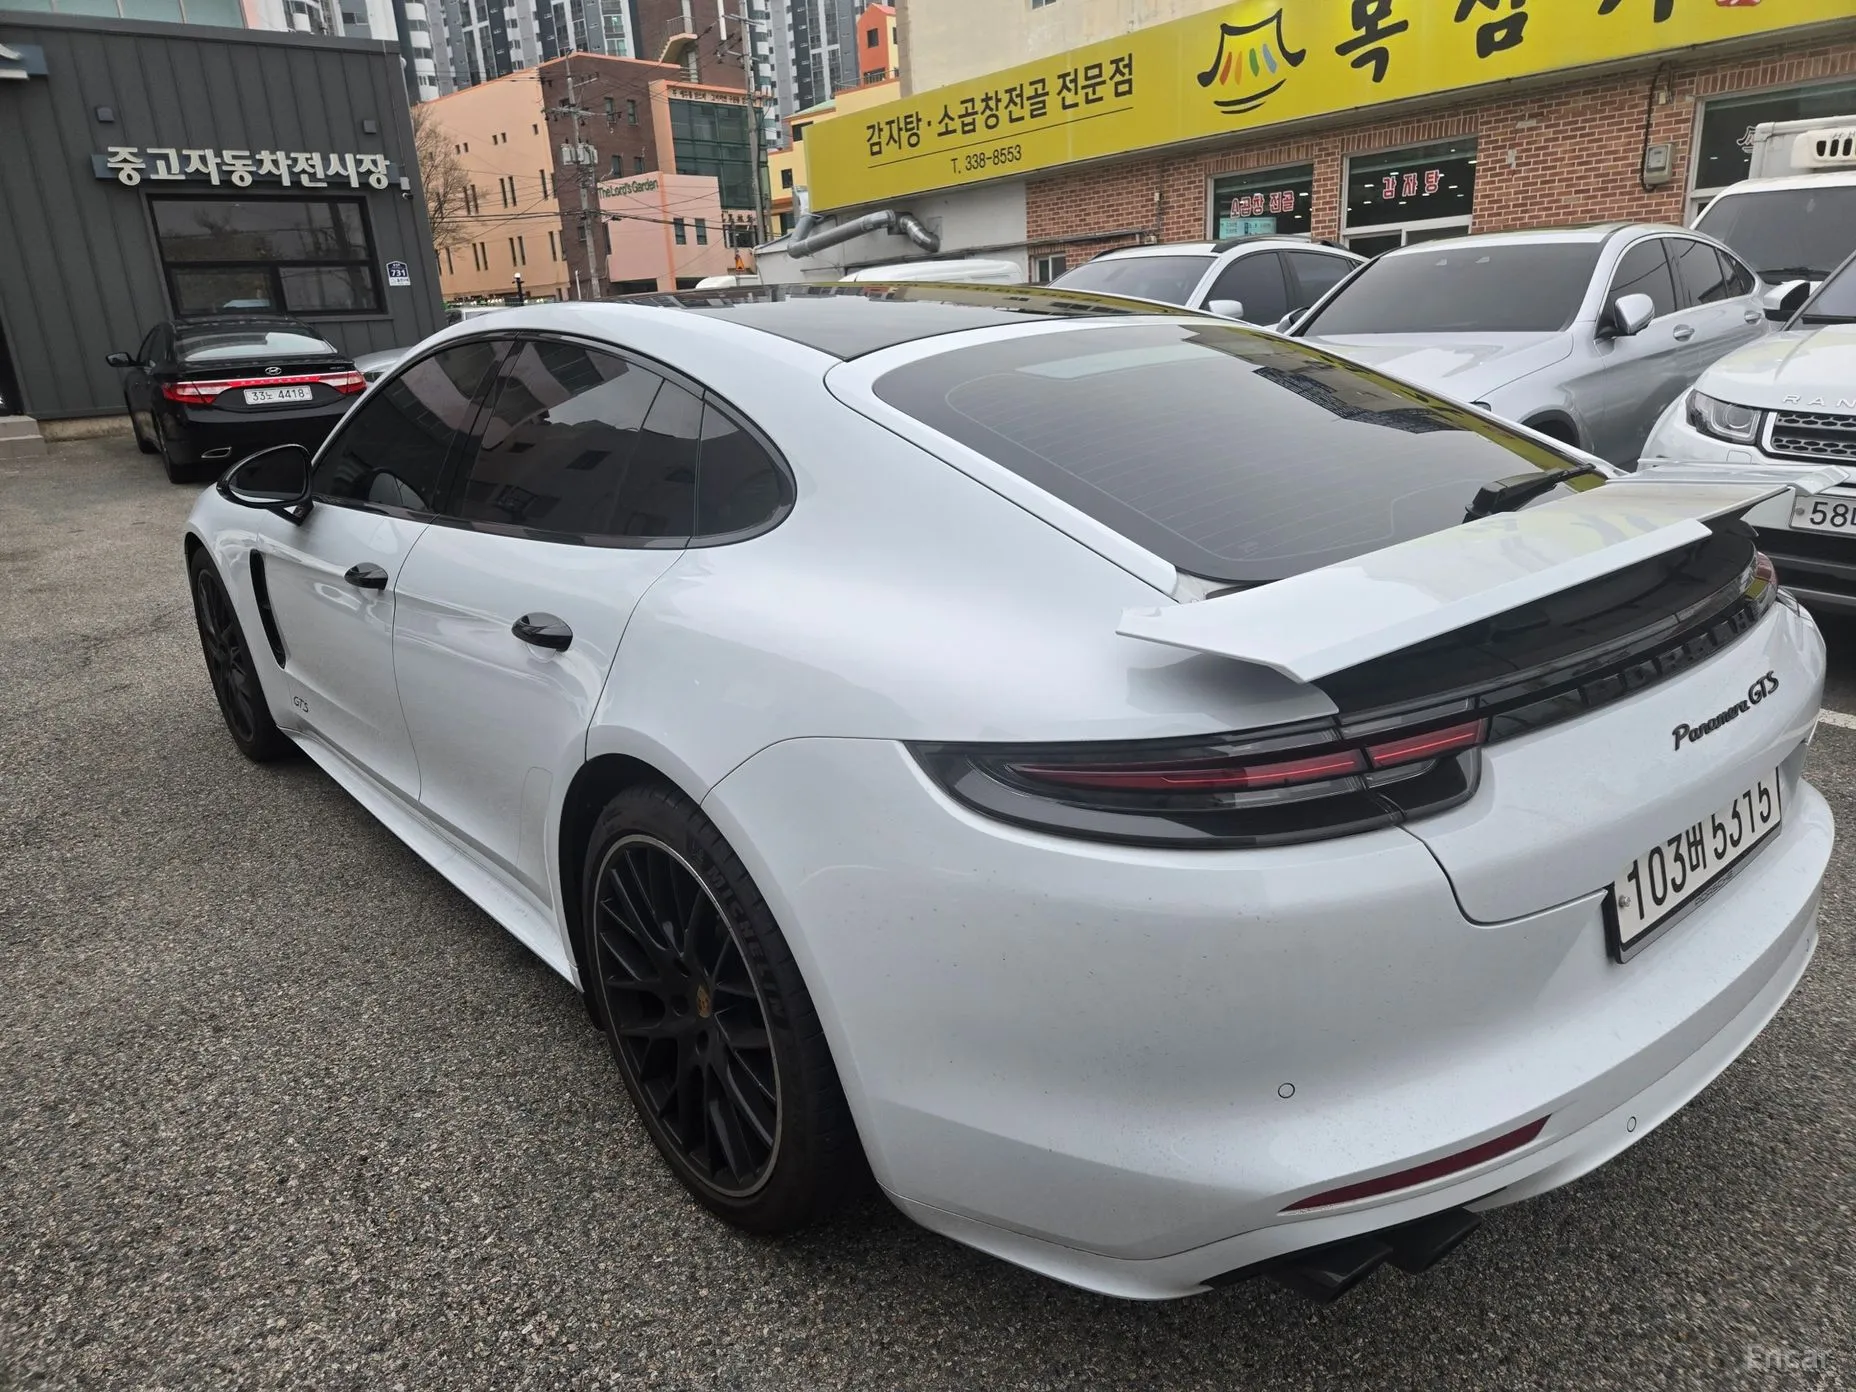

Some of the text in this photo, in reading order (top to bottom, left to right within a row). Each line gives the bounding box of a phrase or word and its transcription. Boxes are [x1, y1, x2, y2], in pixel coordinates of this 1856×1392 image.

[866, 111, 921, 157] 감자탕
[937, 78, 1049, 137] 소곱창전골
[1056, 53, 1133, 111] 전문점
[107, 146, 390, 189] 중고자동차전시장
[951, 144, 1022, 174] T. 338-8553
[1269, 190, 1295, 213] 전골
[390, 269, 406, 277] 731
[278, 388, 305, 399] 4418
[293, 696, 309, 713] GTS
[1672, 670, 1779, 751] Panamera GTS
